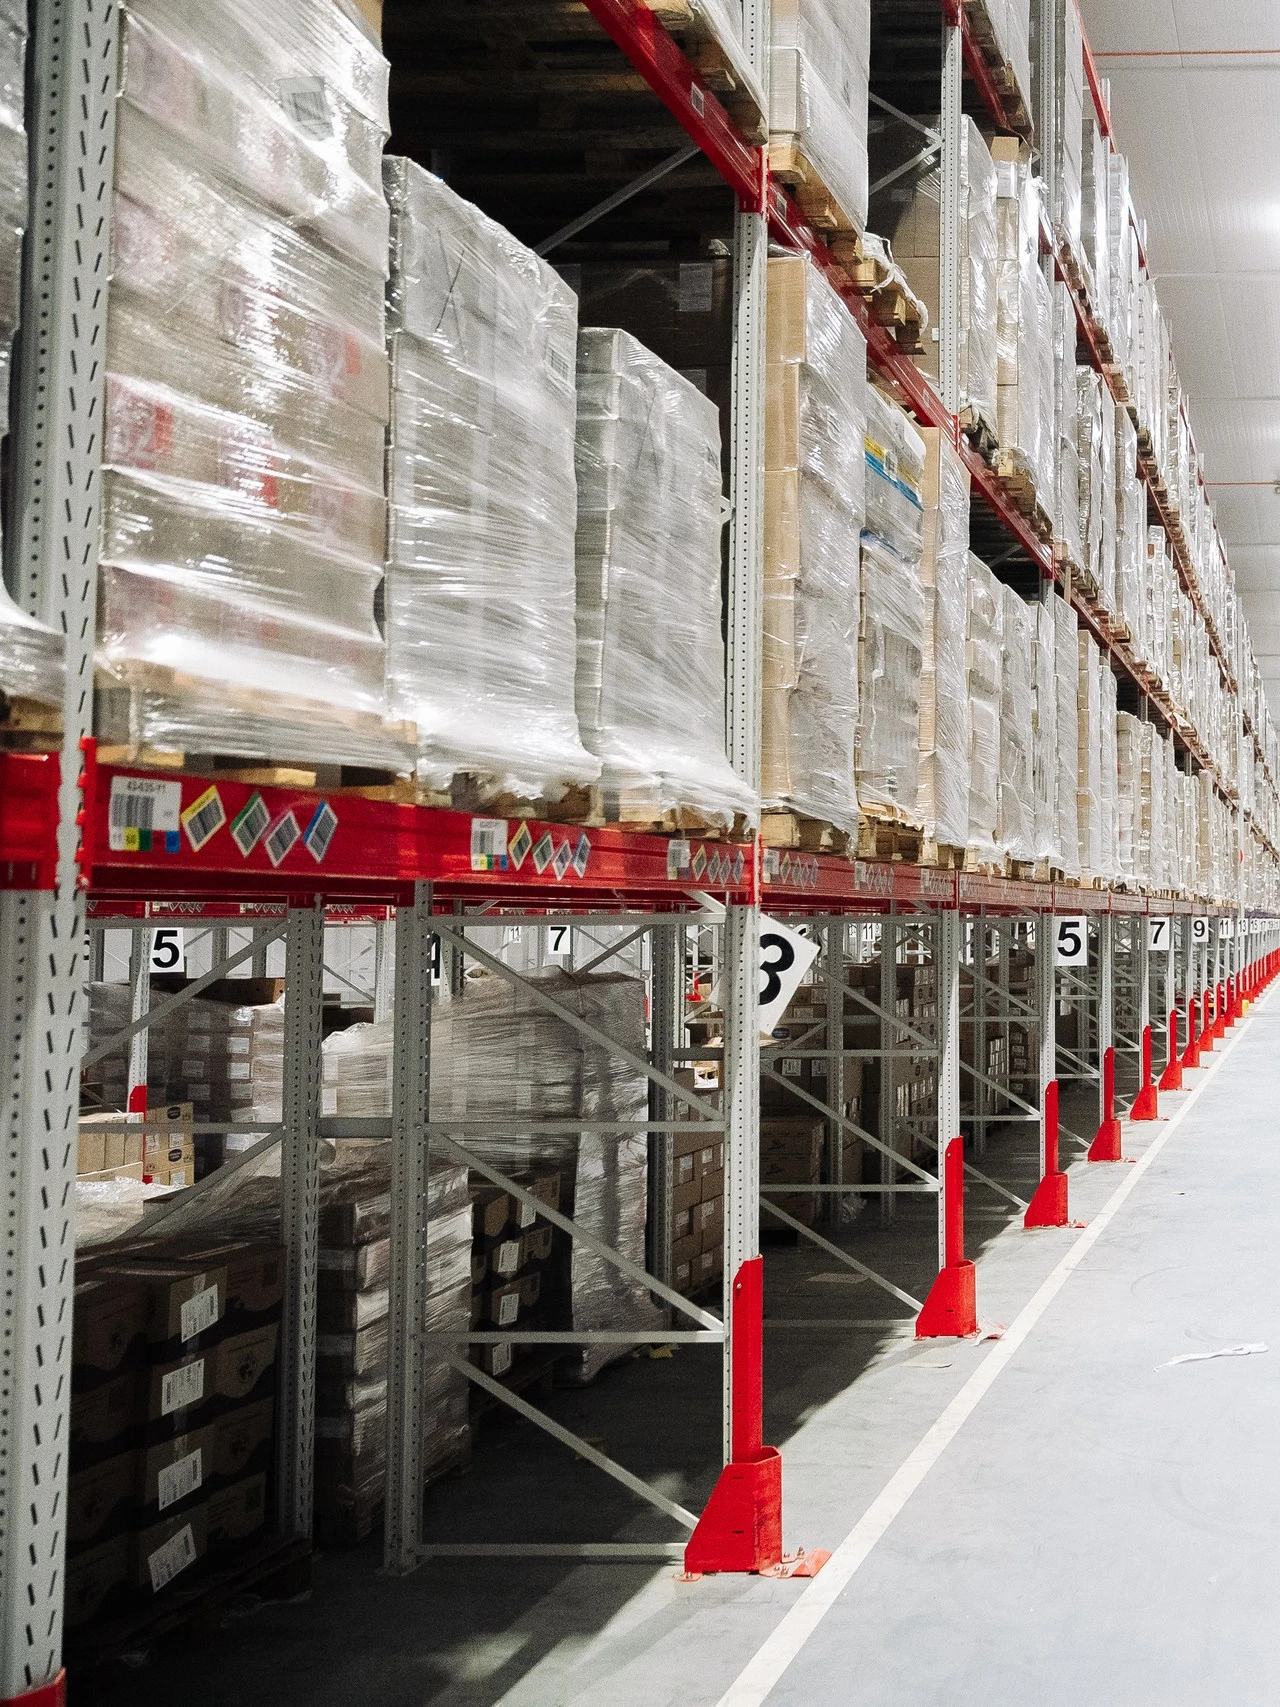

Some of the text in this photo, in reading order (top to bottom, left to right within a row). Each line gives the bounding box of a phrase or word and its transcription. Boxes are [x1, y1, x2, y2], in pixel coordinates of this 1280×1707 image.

[511, 926, 520, 941] 11
[863, 923, 873, 940] 11
[1150, 921, 1165, 944] 7
[1193, 920, 1205, 937] 9
[1220, 920, 1229, 935] 11
[1239, 920, 1246, 933] 13
[1250, 920, 1258, 931] 15
[550, 926, 568, 951] 7
[1057, 921, 1082, 957] 5
[152, 930, 180, 968] 5
[758, 933, 795, 1006] 3
